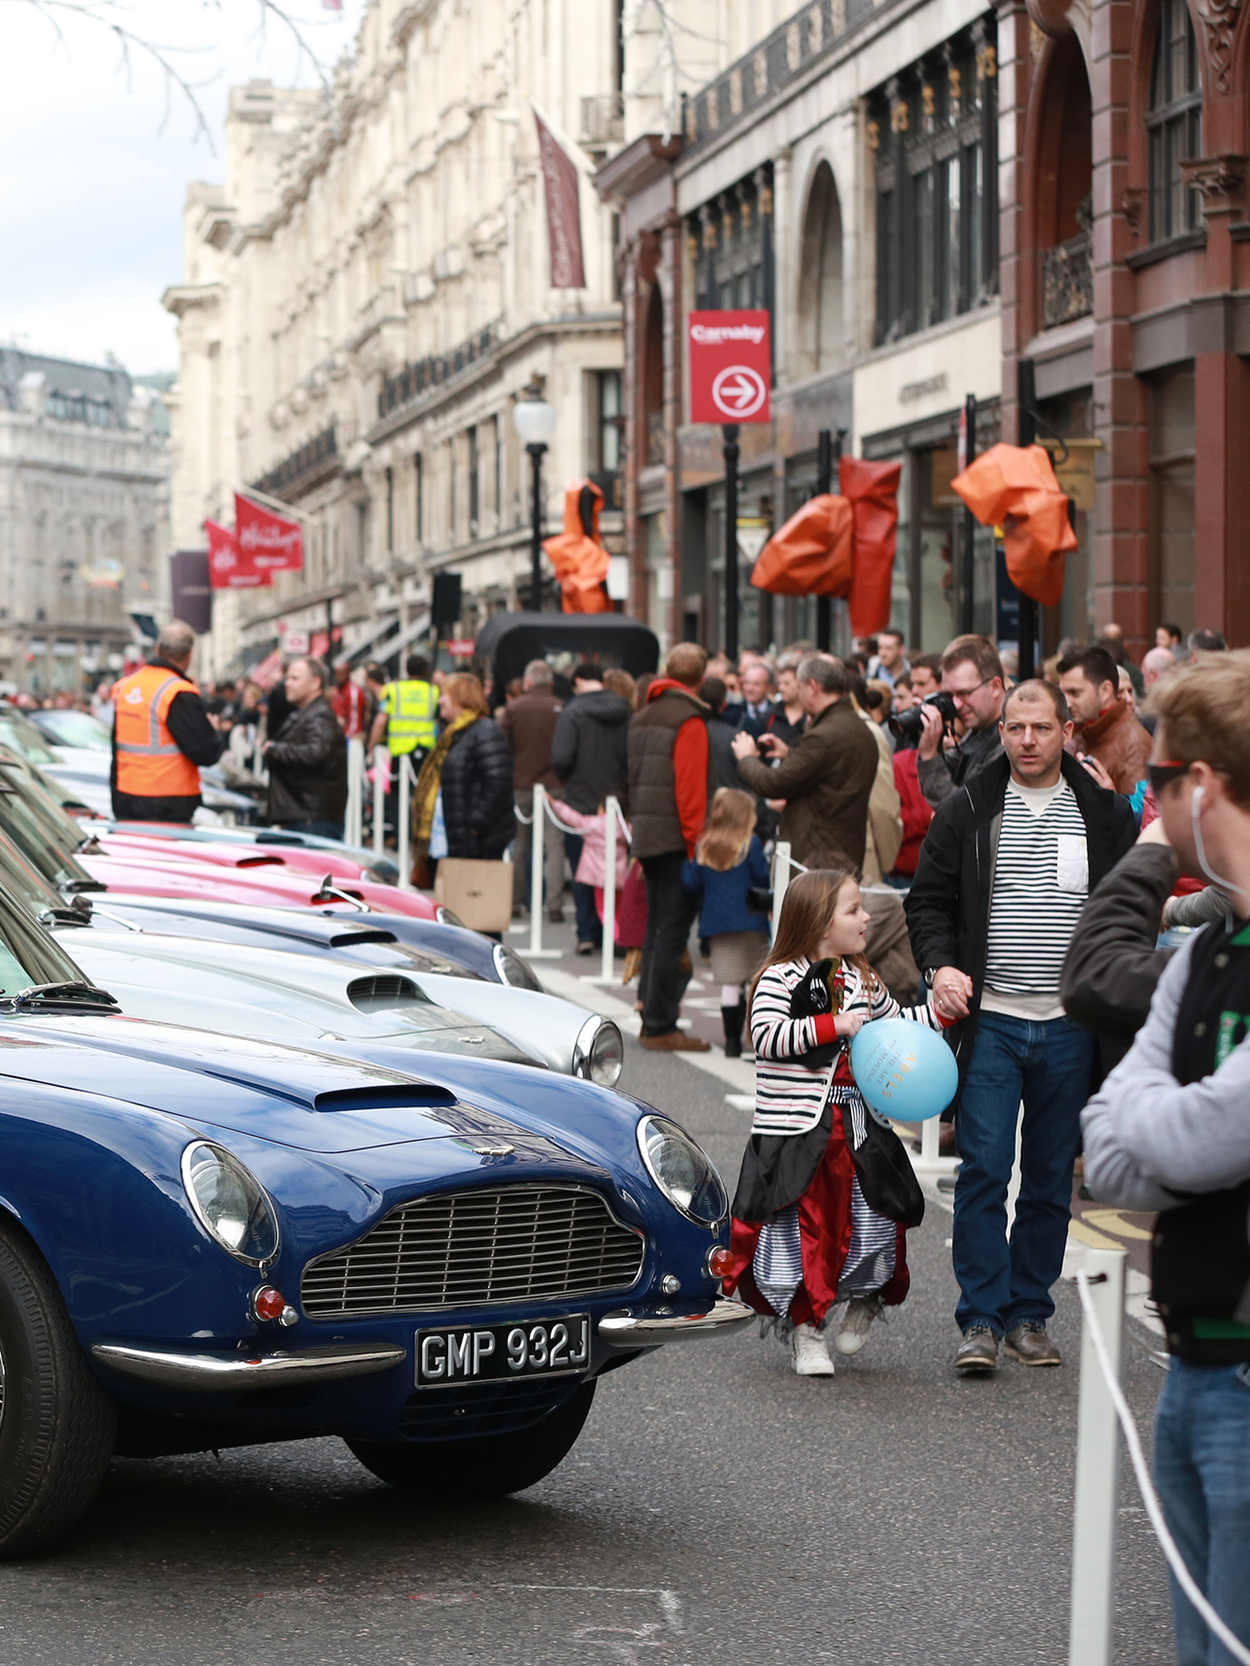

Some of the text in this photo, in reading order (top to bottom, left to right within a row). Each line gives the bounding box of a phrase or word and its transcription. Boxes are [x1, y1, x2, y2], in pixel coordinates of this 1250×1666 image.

[690, 323, 765, 345] Carnaby
[865, 1051, 888, 1082] MOVING
[881, 1051, 917, 1099] ABELS
[421, 1320, 588, 1379] GMP 932J
